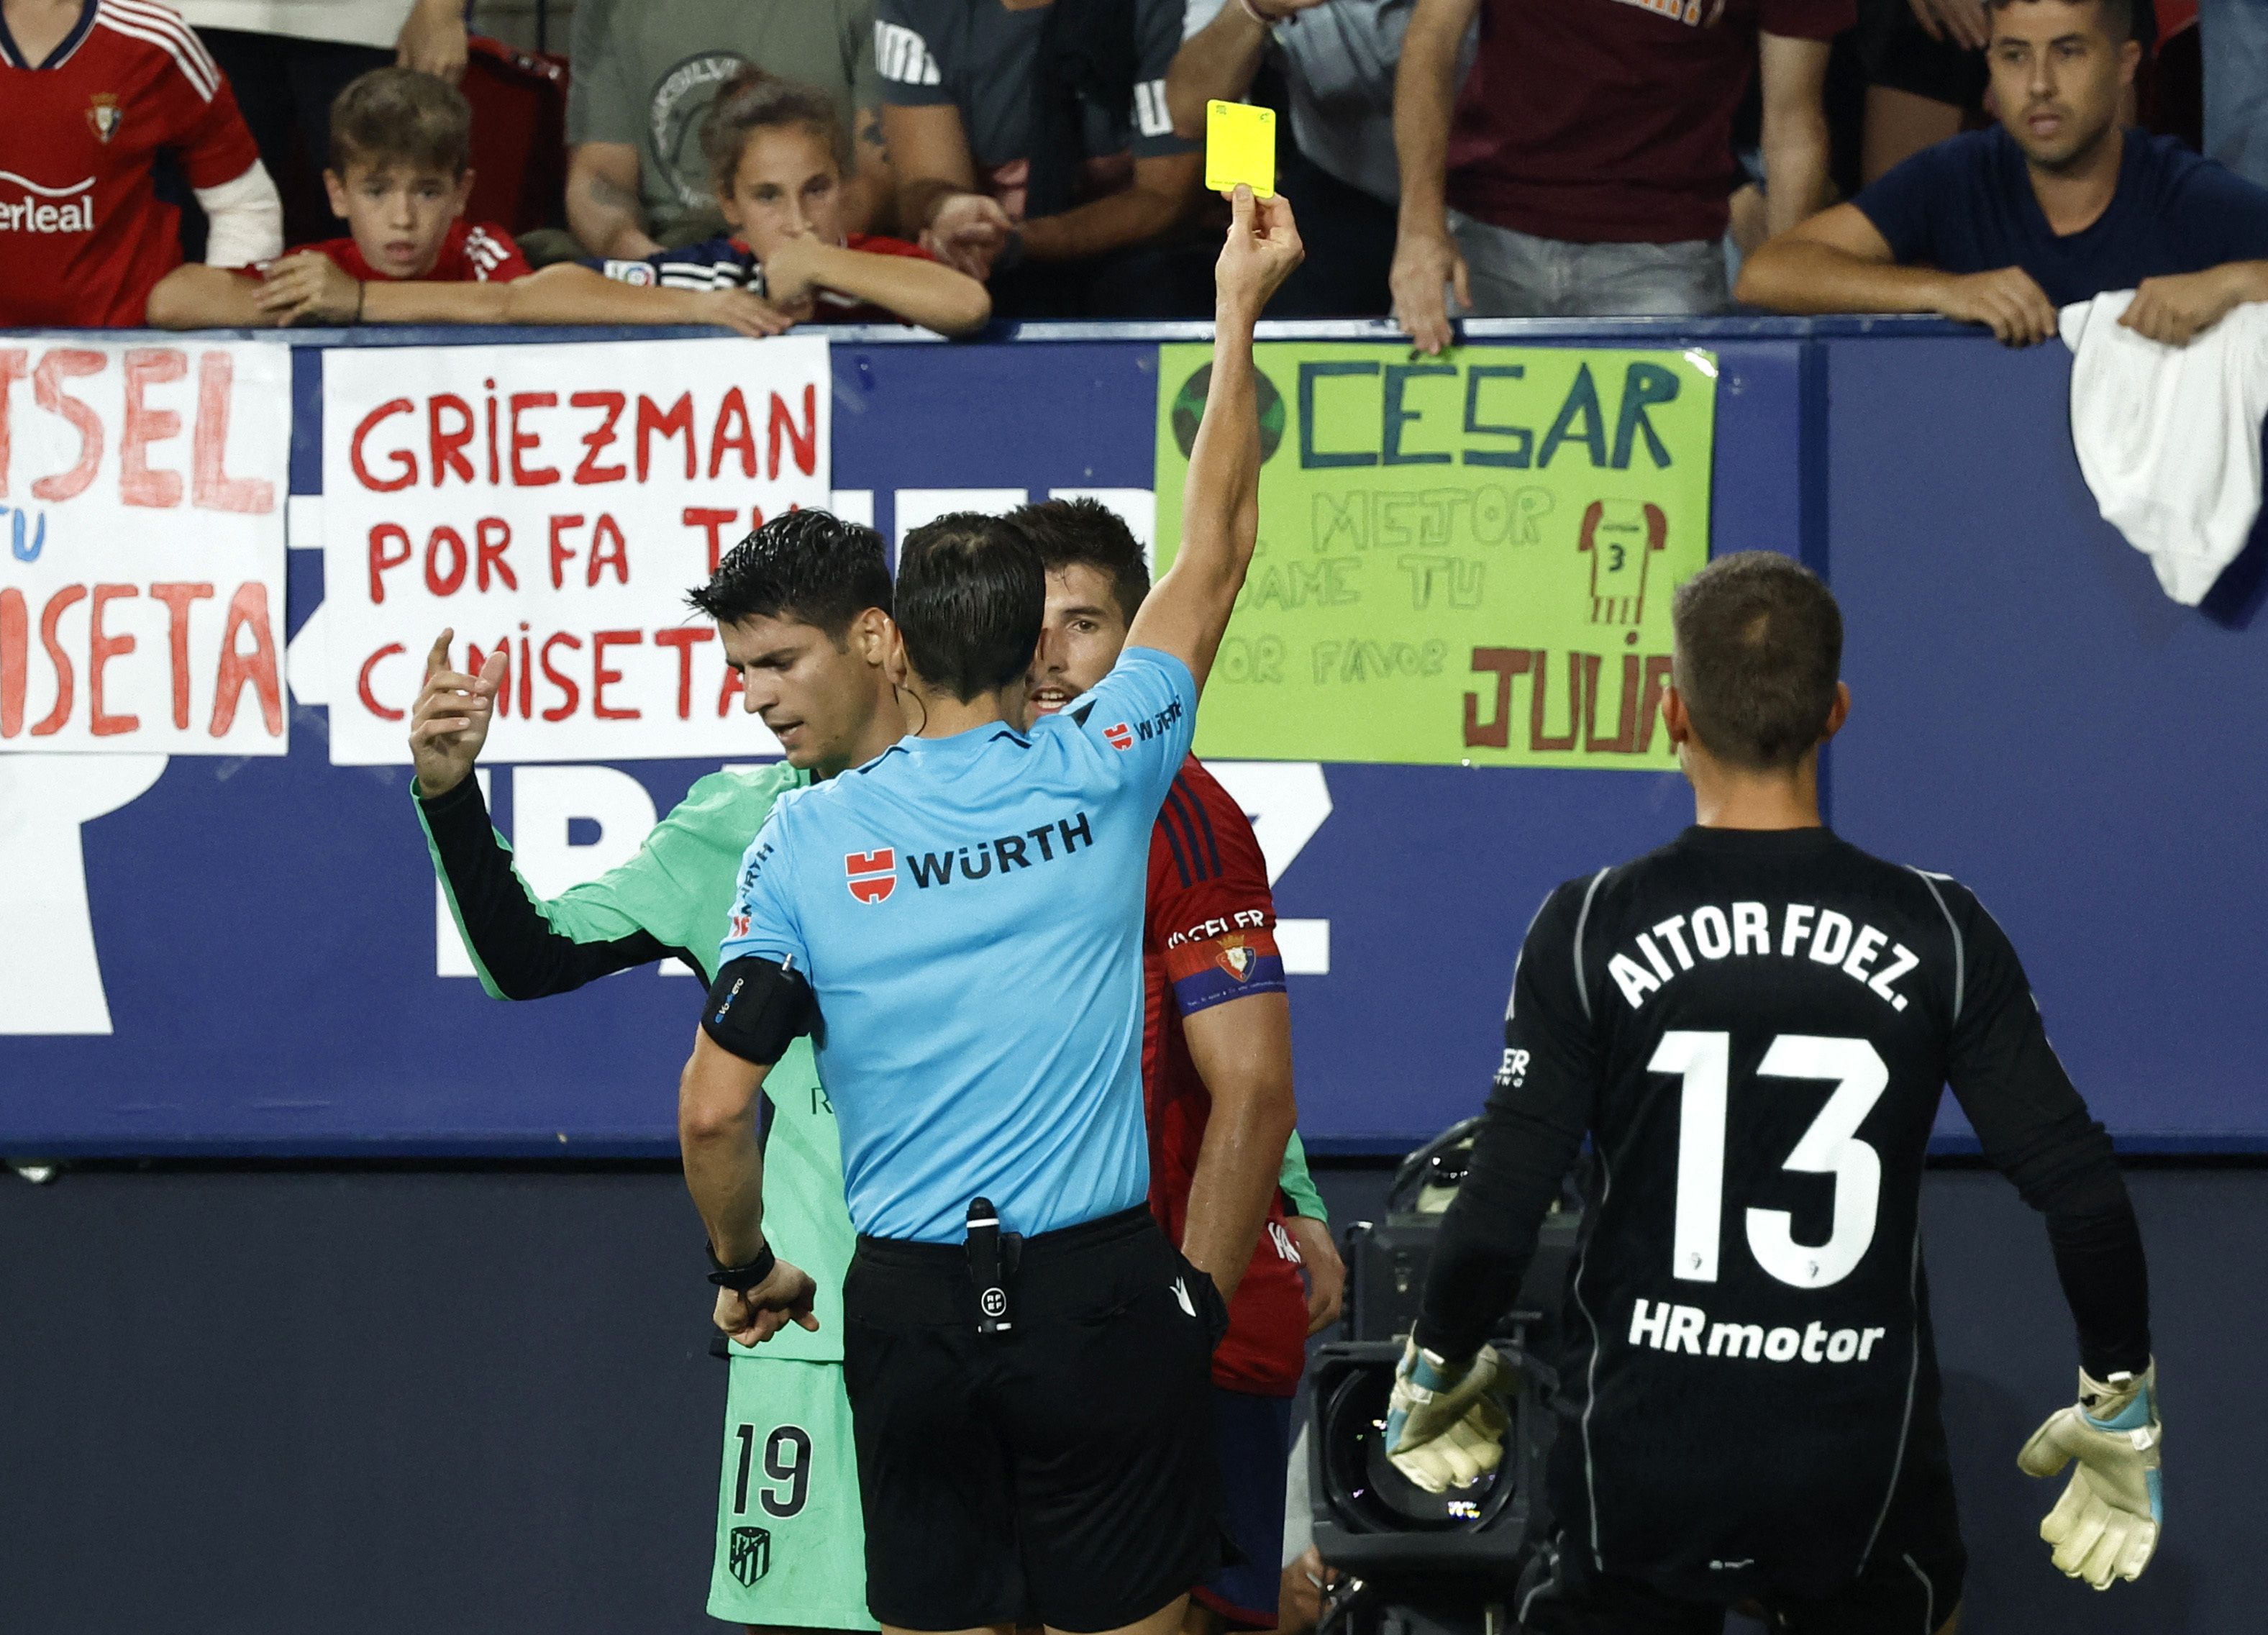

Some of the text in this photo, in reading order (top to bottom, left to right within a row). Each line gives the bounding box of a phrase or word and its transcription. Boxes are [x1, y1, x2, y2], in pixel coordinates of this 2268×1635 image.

[369, 516, 517, 605] POR
[550, 512, 629, 591] FA
[1397, 553, 1486, 612] TU
[1608, 543, 1625, 572] 3
[1607, 901, 1920, 1012] AITOR FDEZ.
[1498, 1047, 1531, 1077] ER
[1646, 1030, 1890, 1289] 13
[734, 1421, 814, 1519] 19
